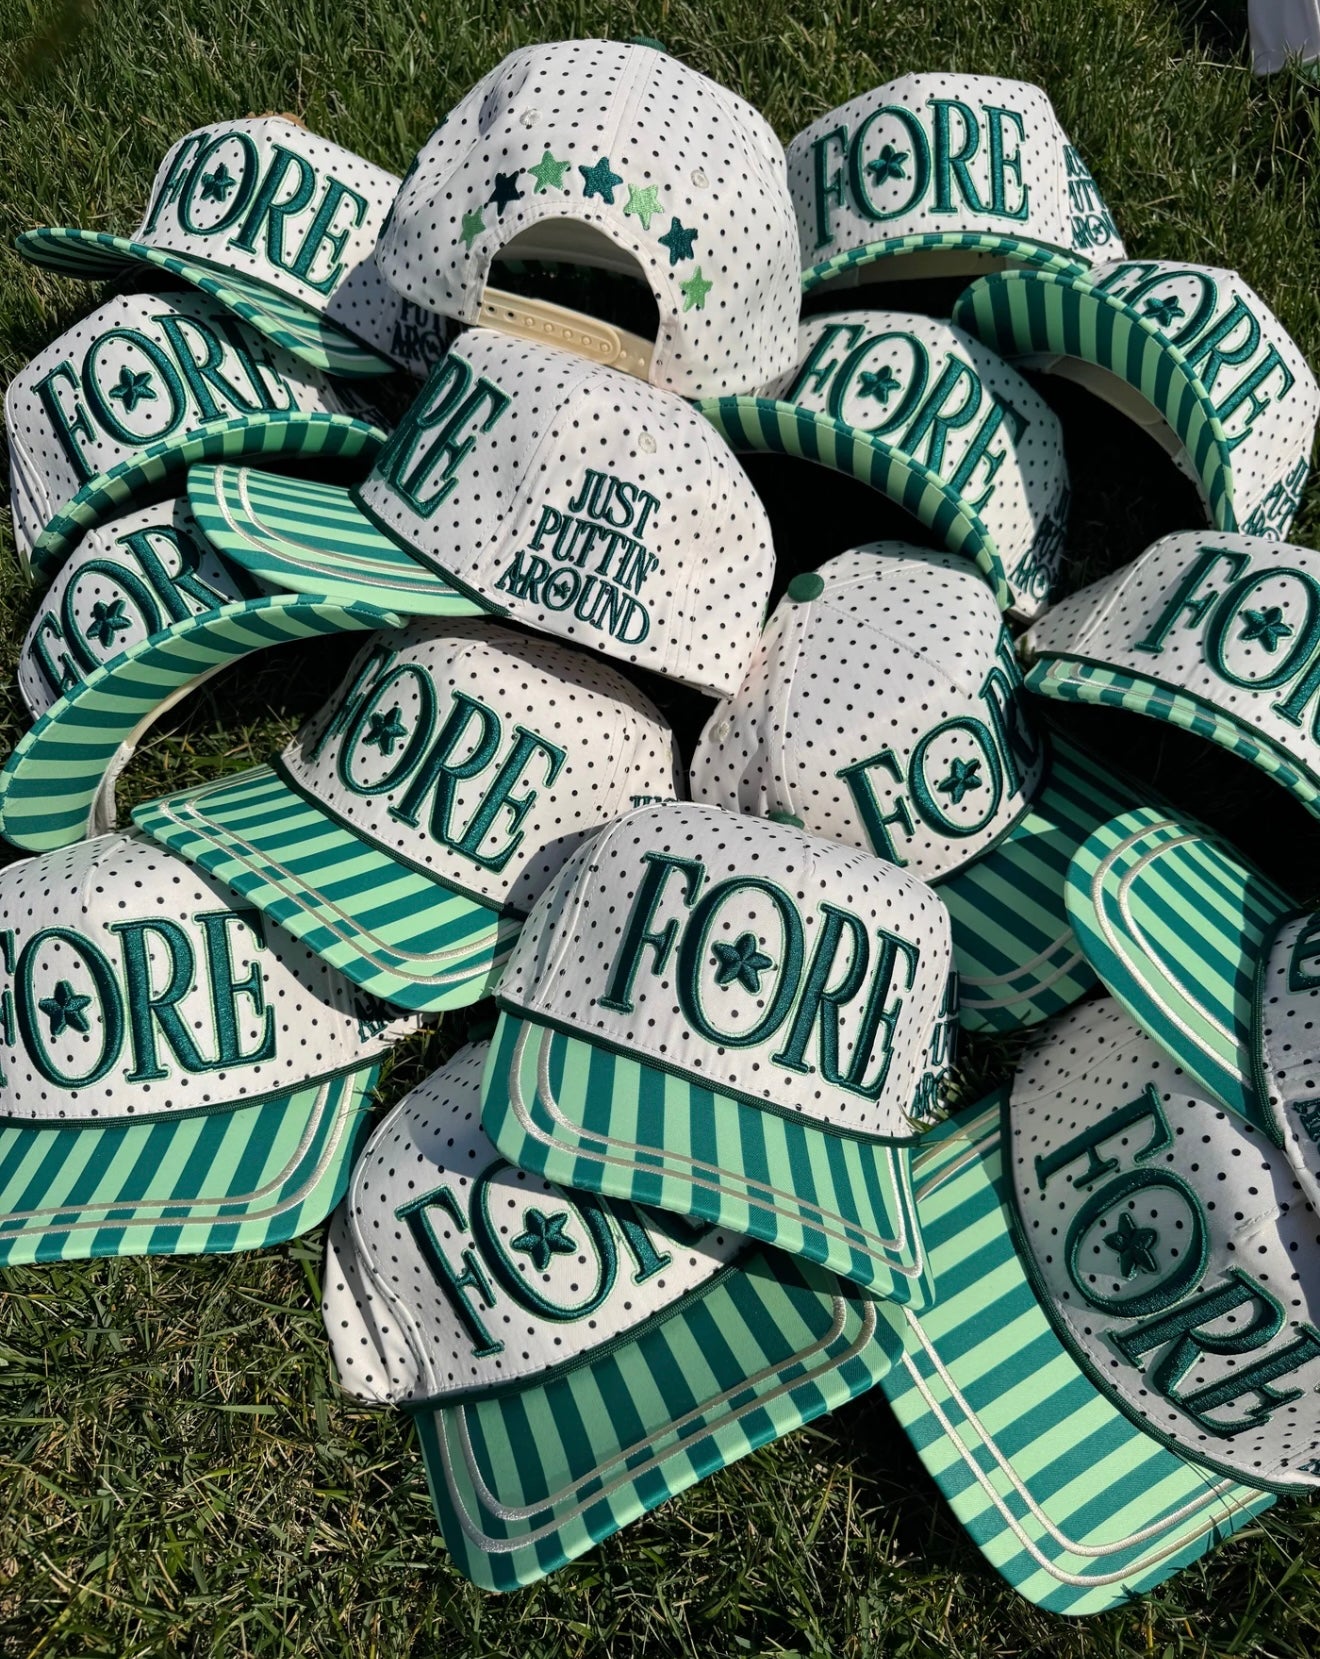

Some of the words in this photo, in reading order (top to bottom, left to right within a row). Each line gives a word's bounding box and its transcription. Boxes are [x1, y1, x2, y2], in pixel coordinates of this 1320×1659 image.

[143, 131, 370, 297] FORE
[811, 98, 1030, 250] FORE
[32, 313, 299, 490] FORE
[376, 351, 512, 520] RE
[787, 323, 1031, 515] FORE
[1094, 263, 1296, 452] FORE
[569, 468, 661, 539] JUST
[29, 524, 228, 697] FOR
[494, 550, 651, 645] AROUND
[308, 644, 568, 875] FORE
[598, 851, 921, 1103] FORE
[1034, 1082, 1320, 1439] FORE
